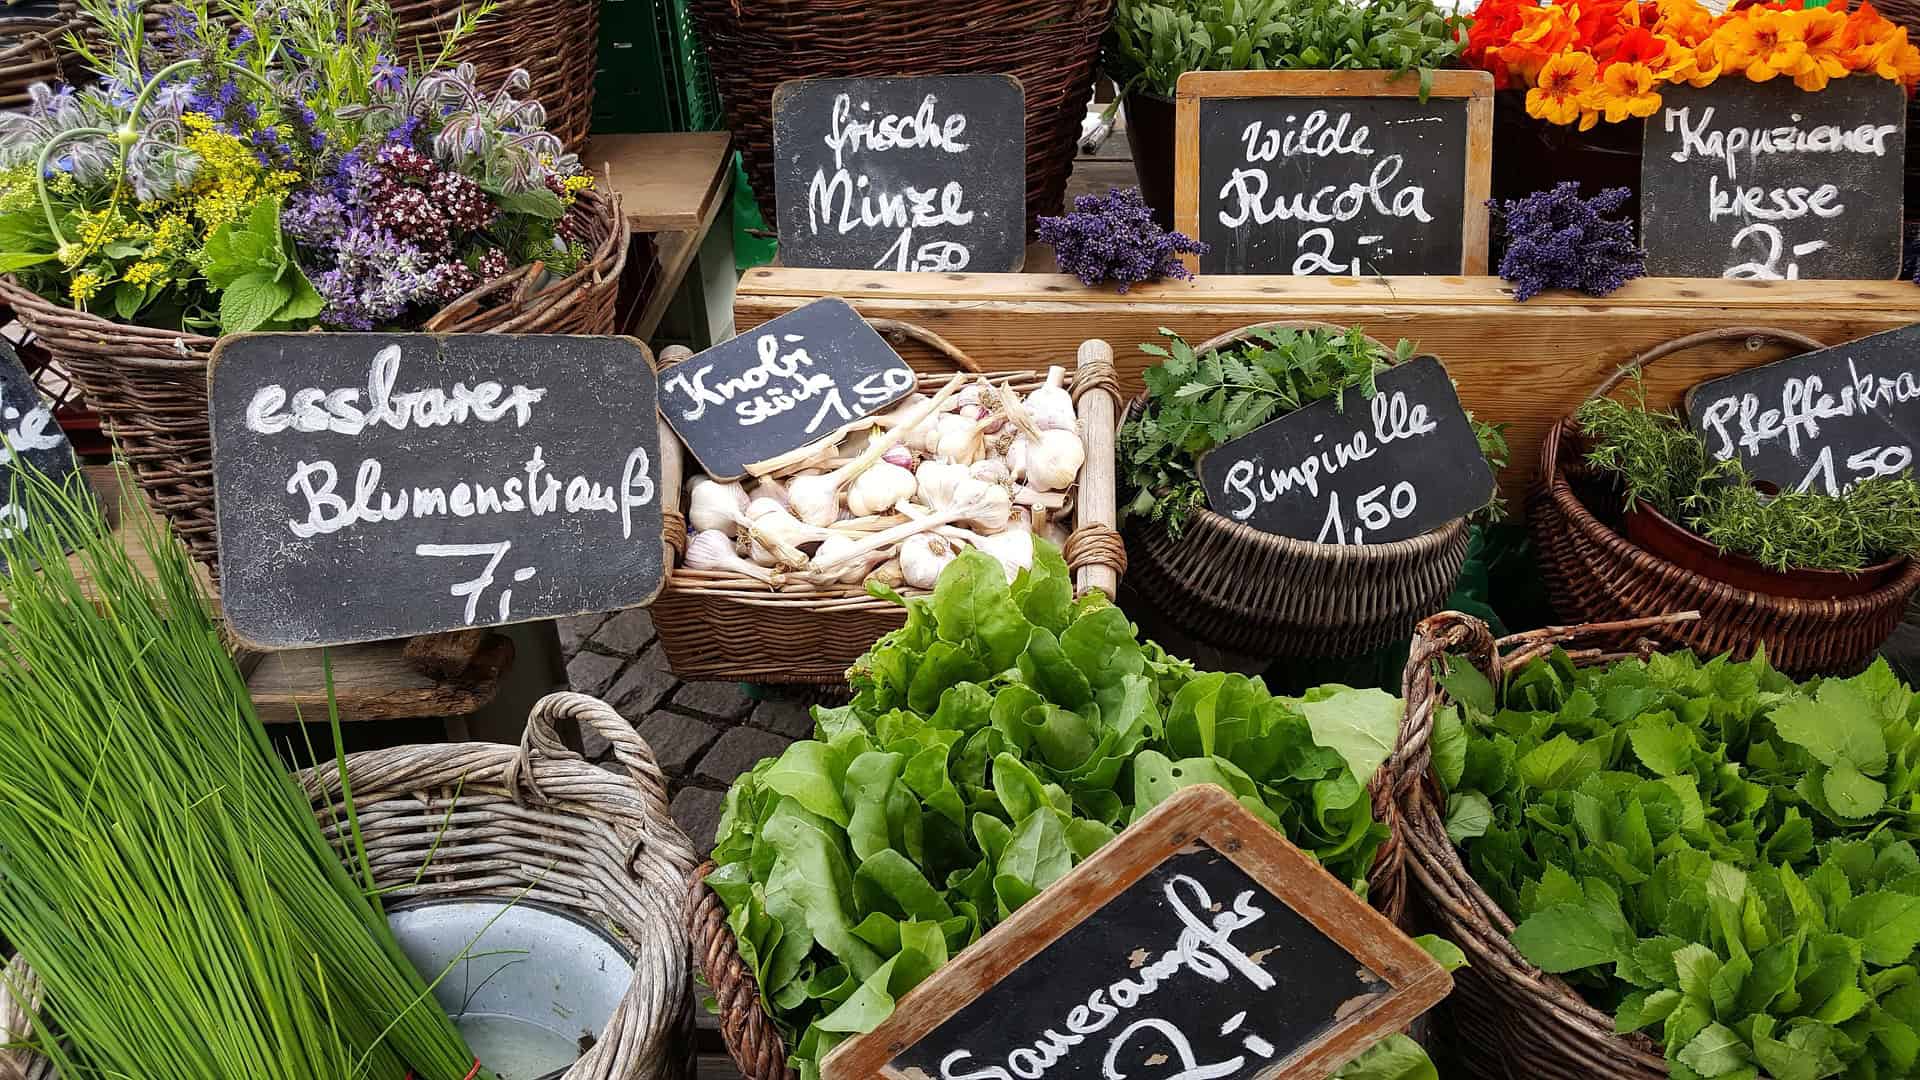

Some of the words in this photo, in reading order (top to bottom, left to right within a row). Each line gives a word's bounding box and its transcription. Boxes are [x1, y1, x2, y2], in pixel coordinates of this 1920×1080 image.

[824, 93, 970, 169] frische
[1241, 110, 1375, 162] wilde
[809, 168, 974, 235] Minze
[1218, 154, 1435, 229] Rucola
[1710, 175, 1844, 223] kresse
[873, 227, 971, 272] 1,50
[246, 344, 547, 435] essbarer
[663, 334, 814, 421] Knobi
[805, 367, 914, 434] 1,50
[1223, 391, 1438, 521] Pimpinelle
[1794, 446, 1913, 498] 1,50
[286, 446, 654, 540] Blumenstrauß
[1317, 481, 1417, 546] 1,50
